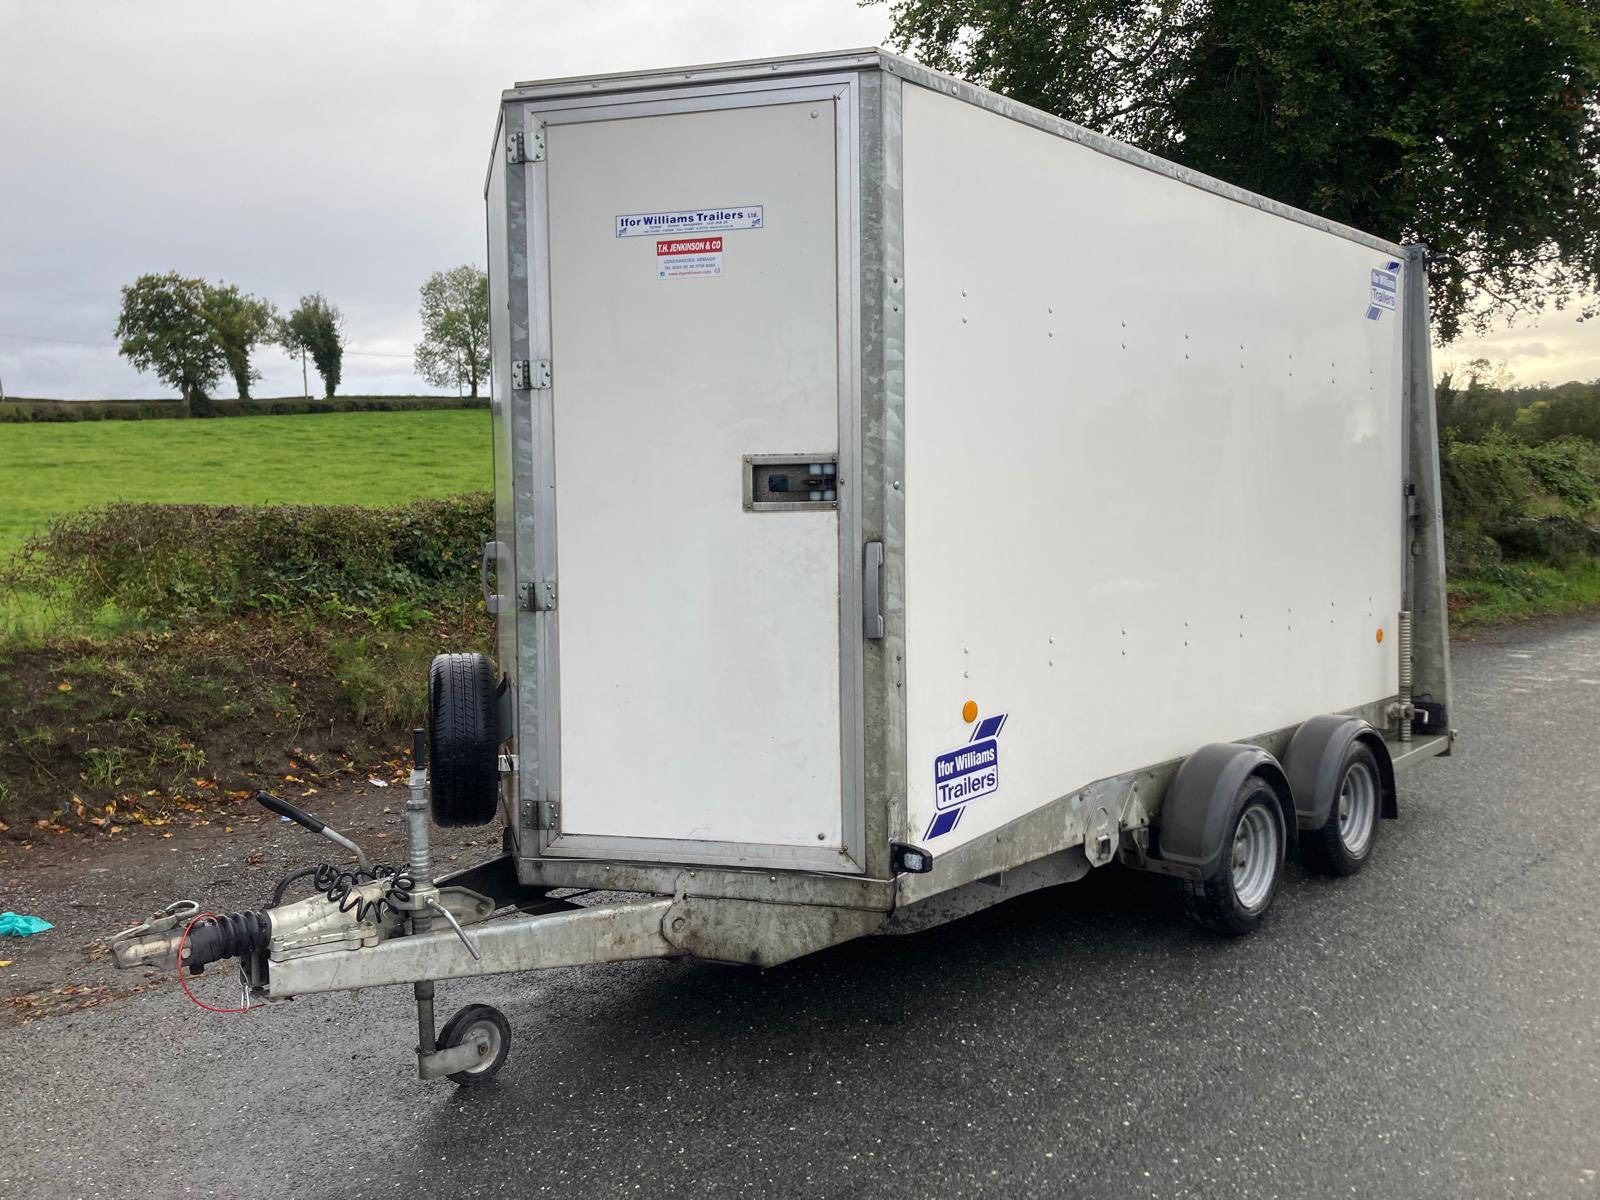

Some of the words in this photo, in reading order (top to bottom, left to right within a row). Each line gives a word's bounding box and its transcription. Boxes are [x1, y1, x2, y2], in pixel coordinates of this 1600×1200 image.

[620, 218, 641, 227] Ifor
[643, 215, 694, 225] Williams
[696, 211, 743, 221] Trailers
[658, 244, 669, 253] T.H.
[669, 241, 704, 252] JENKINSON
[705, 241, 711, 250] &
[711, 240, 721, 250] CO
[1372, 288, 1394, 306] Trailers
[937, 760, 954, 777] Ifor
[955, 748, 995, 771] Williams
[939, 772, 995, 802] Trailers
